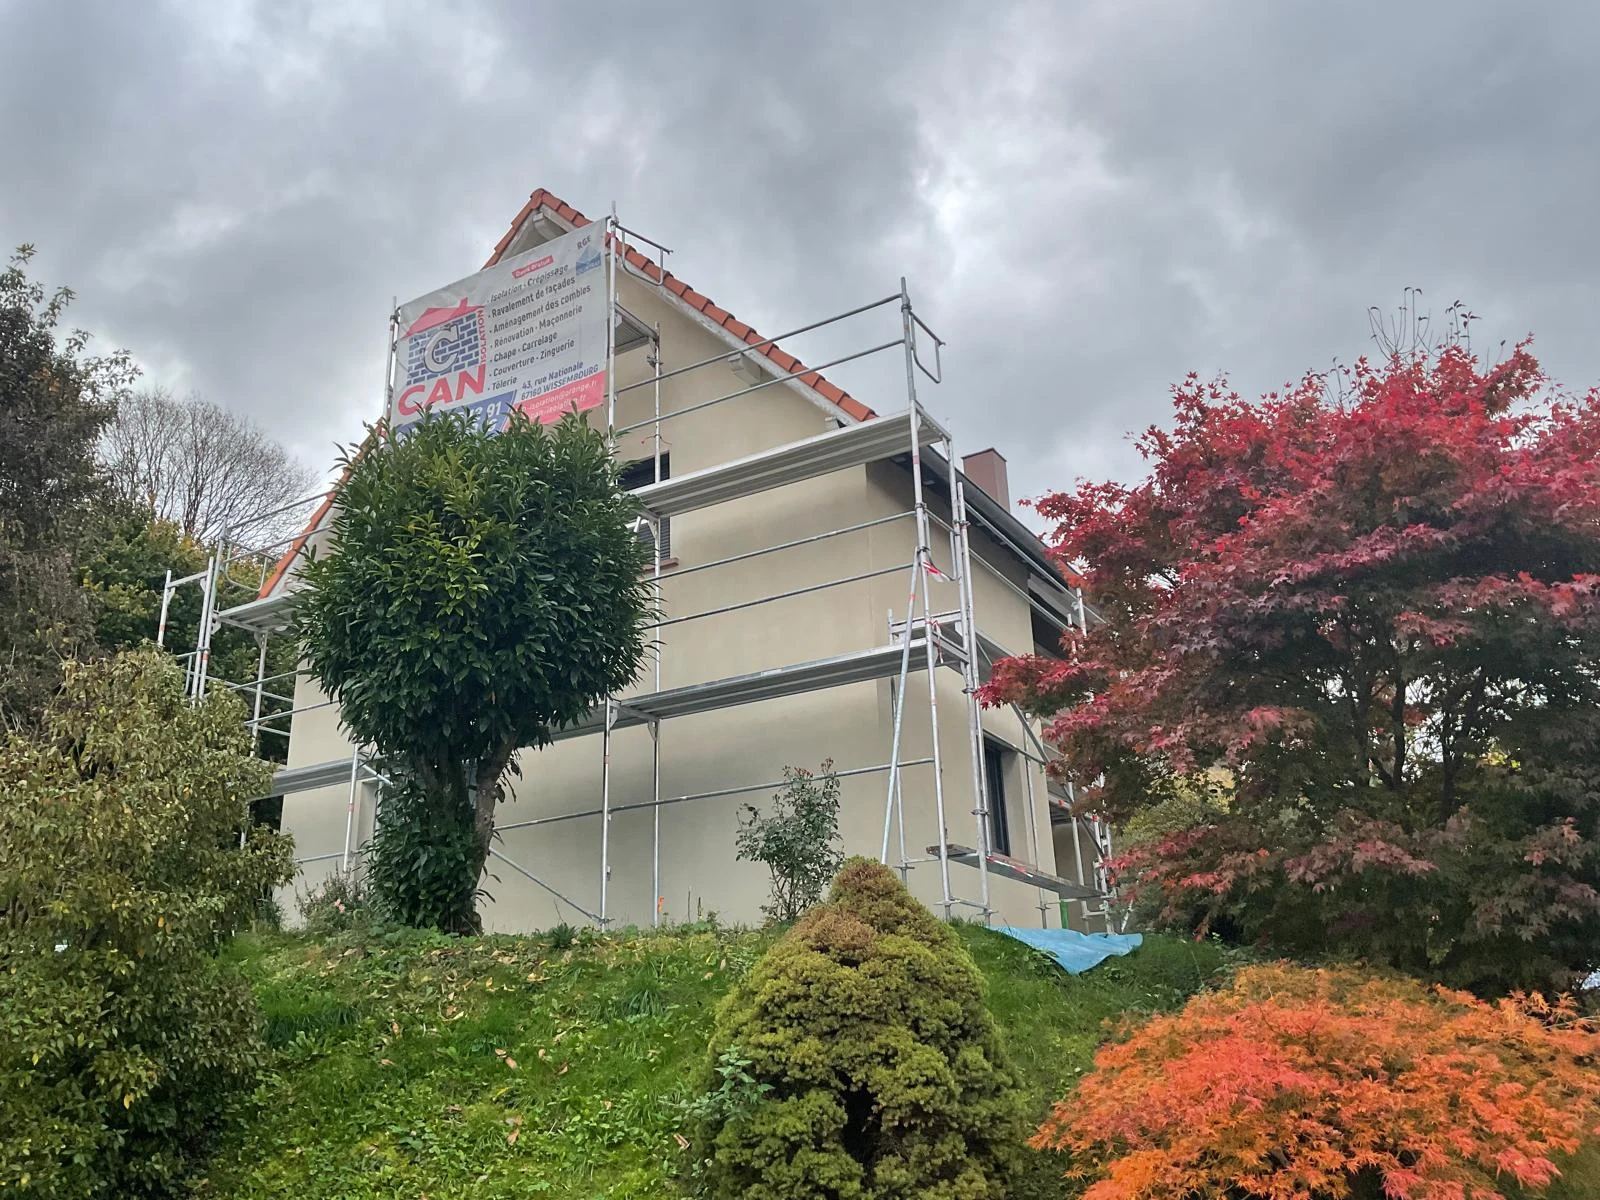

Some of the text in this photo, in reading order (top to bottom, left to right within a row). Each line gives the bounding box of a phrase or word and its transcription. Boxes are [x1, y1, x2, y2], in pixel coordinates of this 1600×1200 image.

[577, 235, 592, 250] RGE
[491, 284, 522, 302] Isolation
[527, 264, 569, 288] Crépissage
[492, 276, 575, 318] Ravalement de façades
[494, 285, 591, 334] Aménagement des combles
[494, 305, 582, 348] Rénovation Maçonnerie
[477, 310, 487, 364] ISOLATION
[494, 332, 558, 362] Chape Carrelage
[493, 339, 574, 377] Couverture Zinguerie
[535, 376, 547, 386] rue
[549, 360, 583, 380] Nationale
[398, 364, 486, 416] CAN
[492, 376, 517, 391] Tôlerie
[543, 364, 599, 394] WISSEMBOURG
[487, 401, 502, 418] 91
